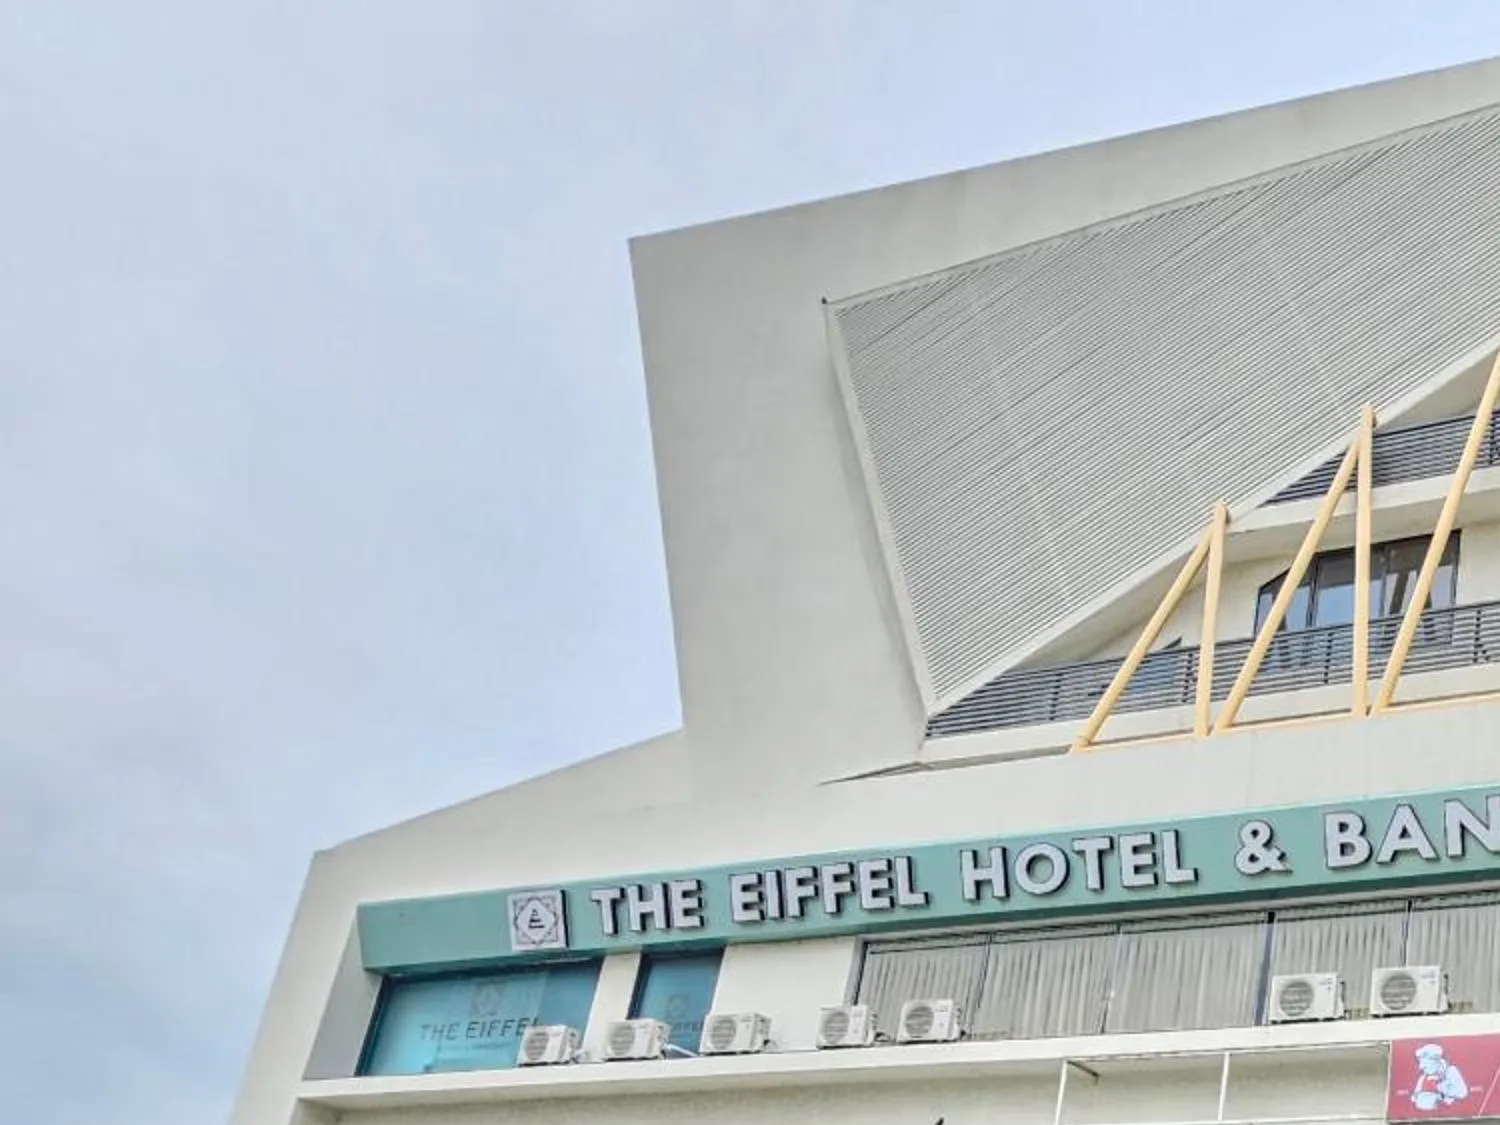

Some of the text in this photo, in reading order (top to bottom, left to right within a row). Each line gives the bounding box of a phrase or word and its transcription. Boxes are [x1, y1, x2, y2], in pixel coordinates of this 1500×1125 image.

[591, 877, 706, 935] THE
[730, 856, 929, 923] EIFFEL
[959, 828, 1199, 902] HOTEL
[1234, 819, 1292, 876] &
[420, 1021, 460, 1041] THE
